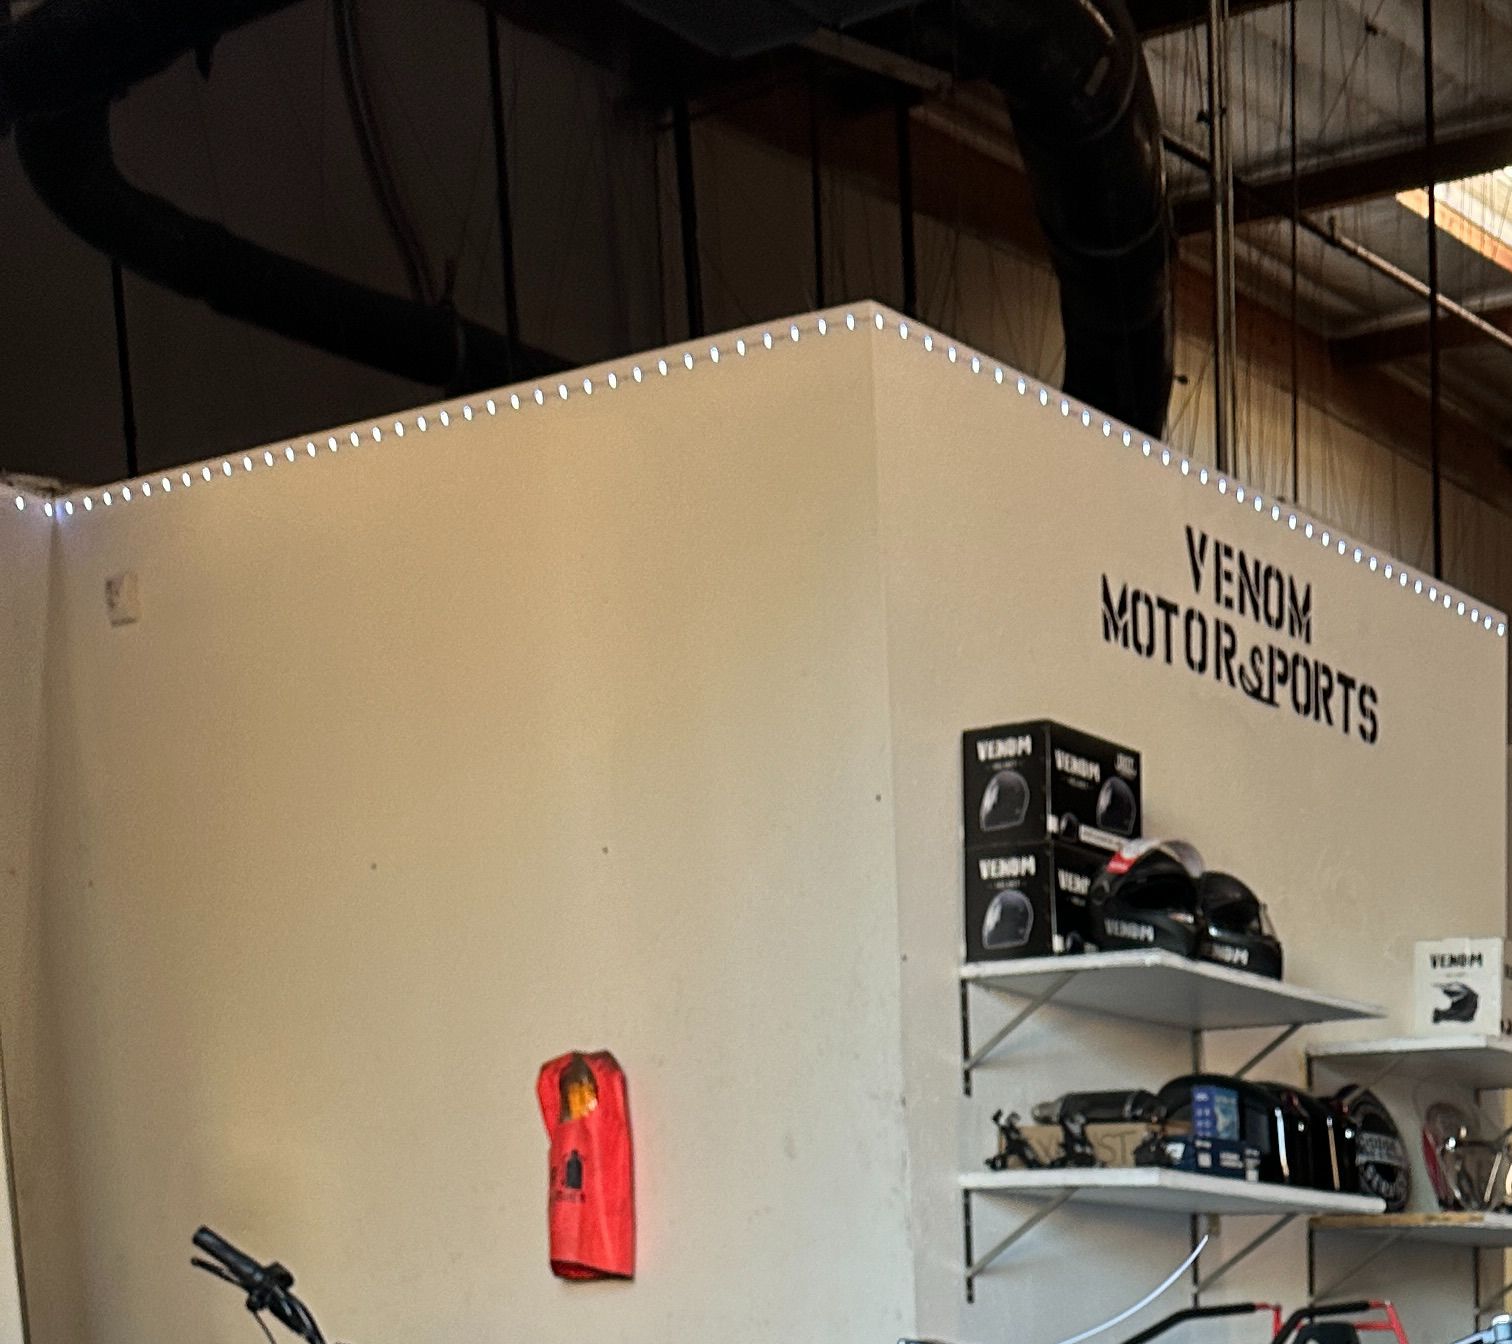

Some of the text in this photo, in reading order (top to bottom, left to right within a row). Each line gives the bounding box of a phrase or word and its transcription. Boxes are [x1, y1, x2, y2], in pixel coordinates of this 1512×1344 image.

[1185, 524, 1312, 645] VENOM
[1102, 572, 1378, 744] MOTORSPORTS
[976, 735, 1032, 762] VENOM
[1054, 749, 1101, 783] VENOM
[978, 854, 1036, 880] VENOM
[1104, 918, 1155, 942] VENOM
[1429, 951, 1483, 969] VENOM
